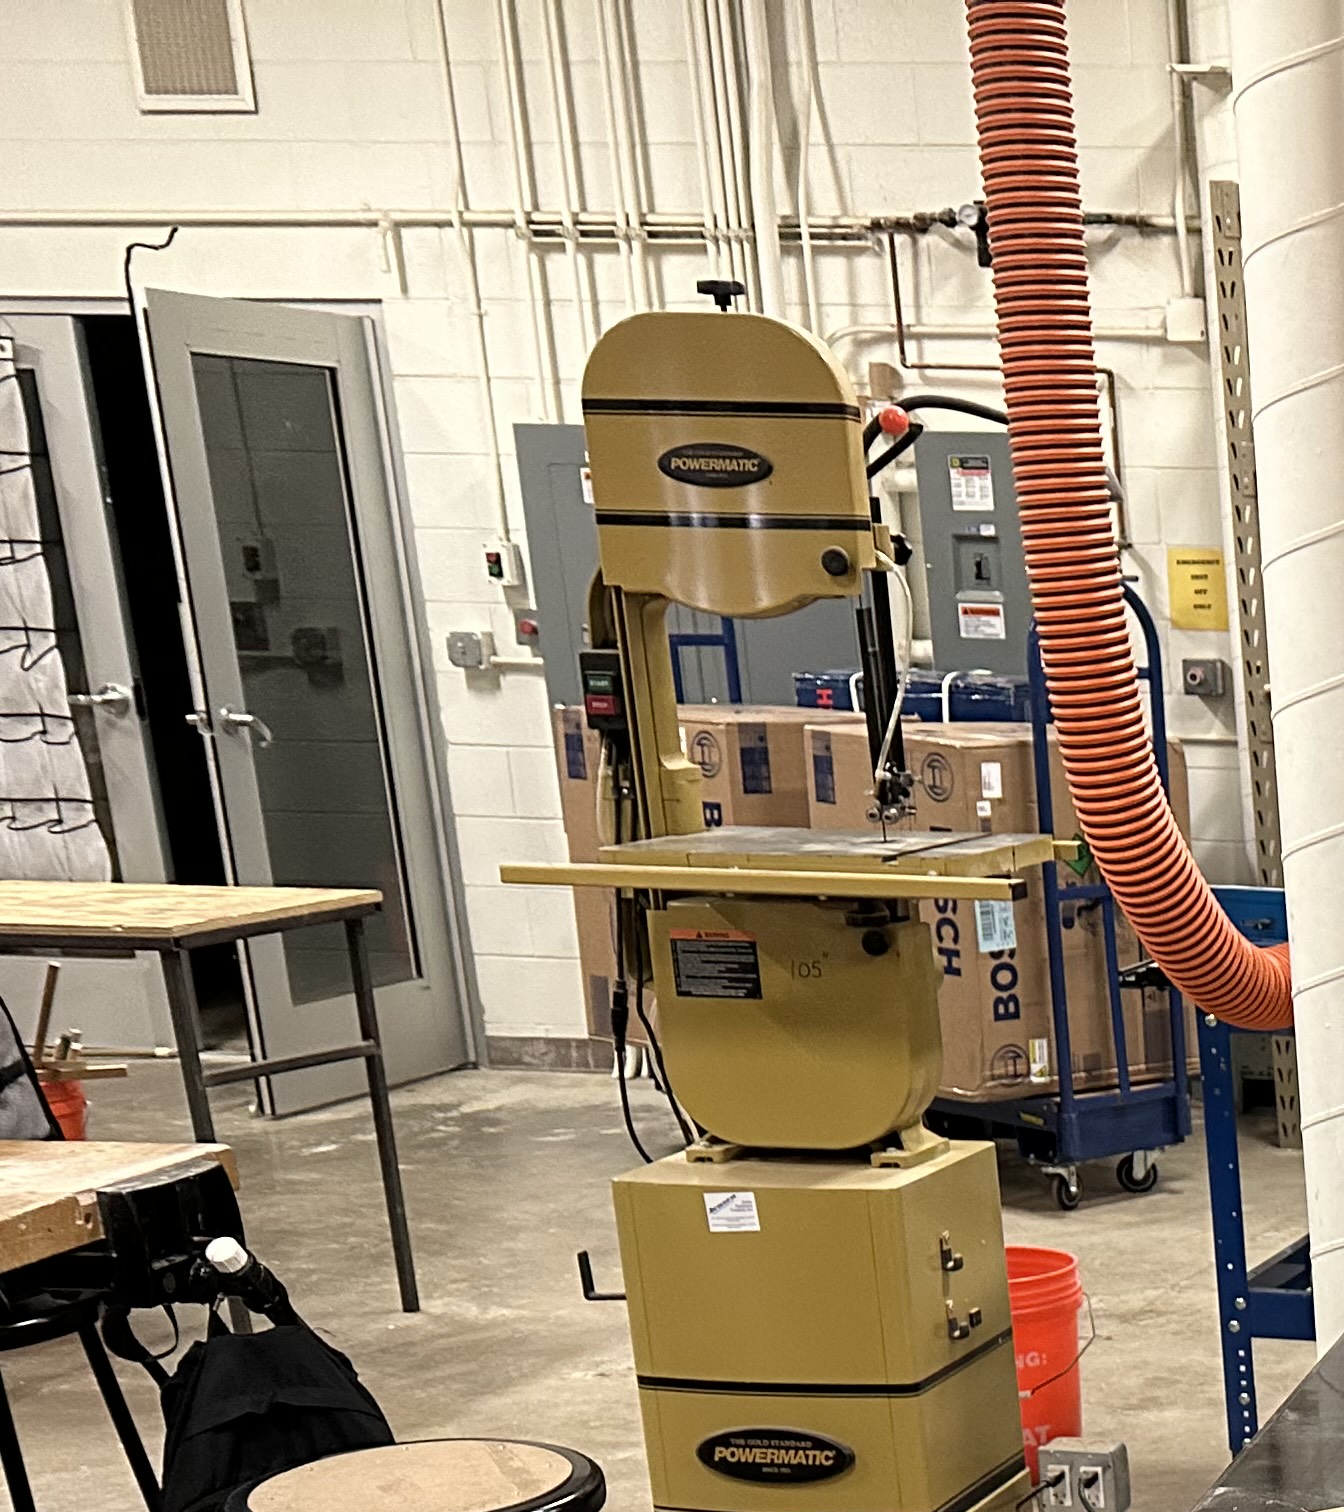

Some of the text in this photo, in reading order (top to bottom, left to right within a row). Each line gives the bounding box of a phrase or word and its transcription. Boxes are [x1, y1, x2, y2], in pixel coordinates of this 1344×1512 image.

[670, 457, 759, 472] POWERMATIC
[747, 1438, 769, 1447] GOLD
[713, 1446, 835, 1466] POWERMATIC
